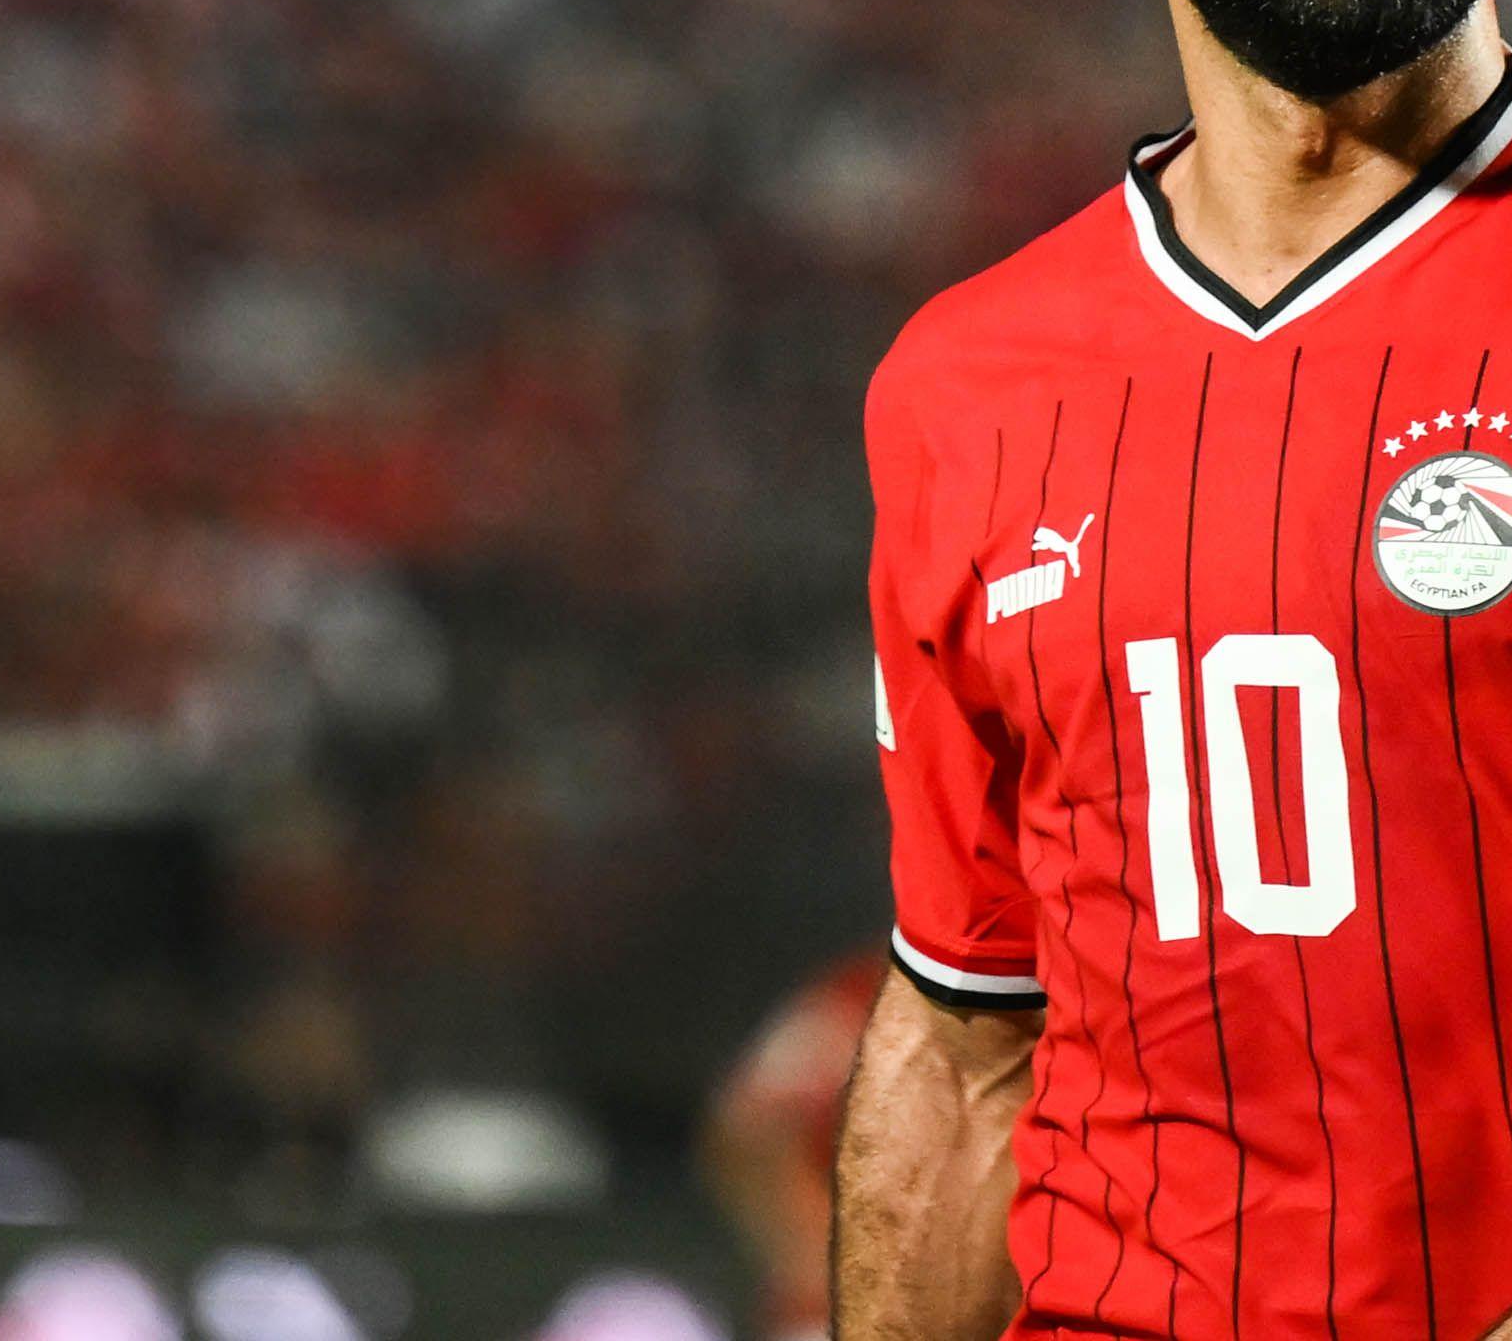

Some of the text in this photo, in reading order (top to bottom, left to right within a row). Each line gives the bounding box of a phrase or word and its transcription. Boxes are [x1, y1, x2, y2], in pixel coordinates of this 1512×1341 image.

[987, 559, 1066, 624] PUMA
[1410, 579, 1488, 599] EGYPTIAN FA
[1125, 634, 1357, 942] 10
